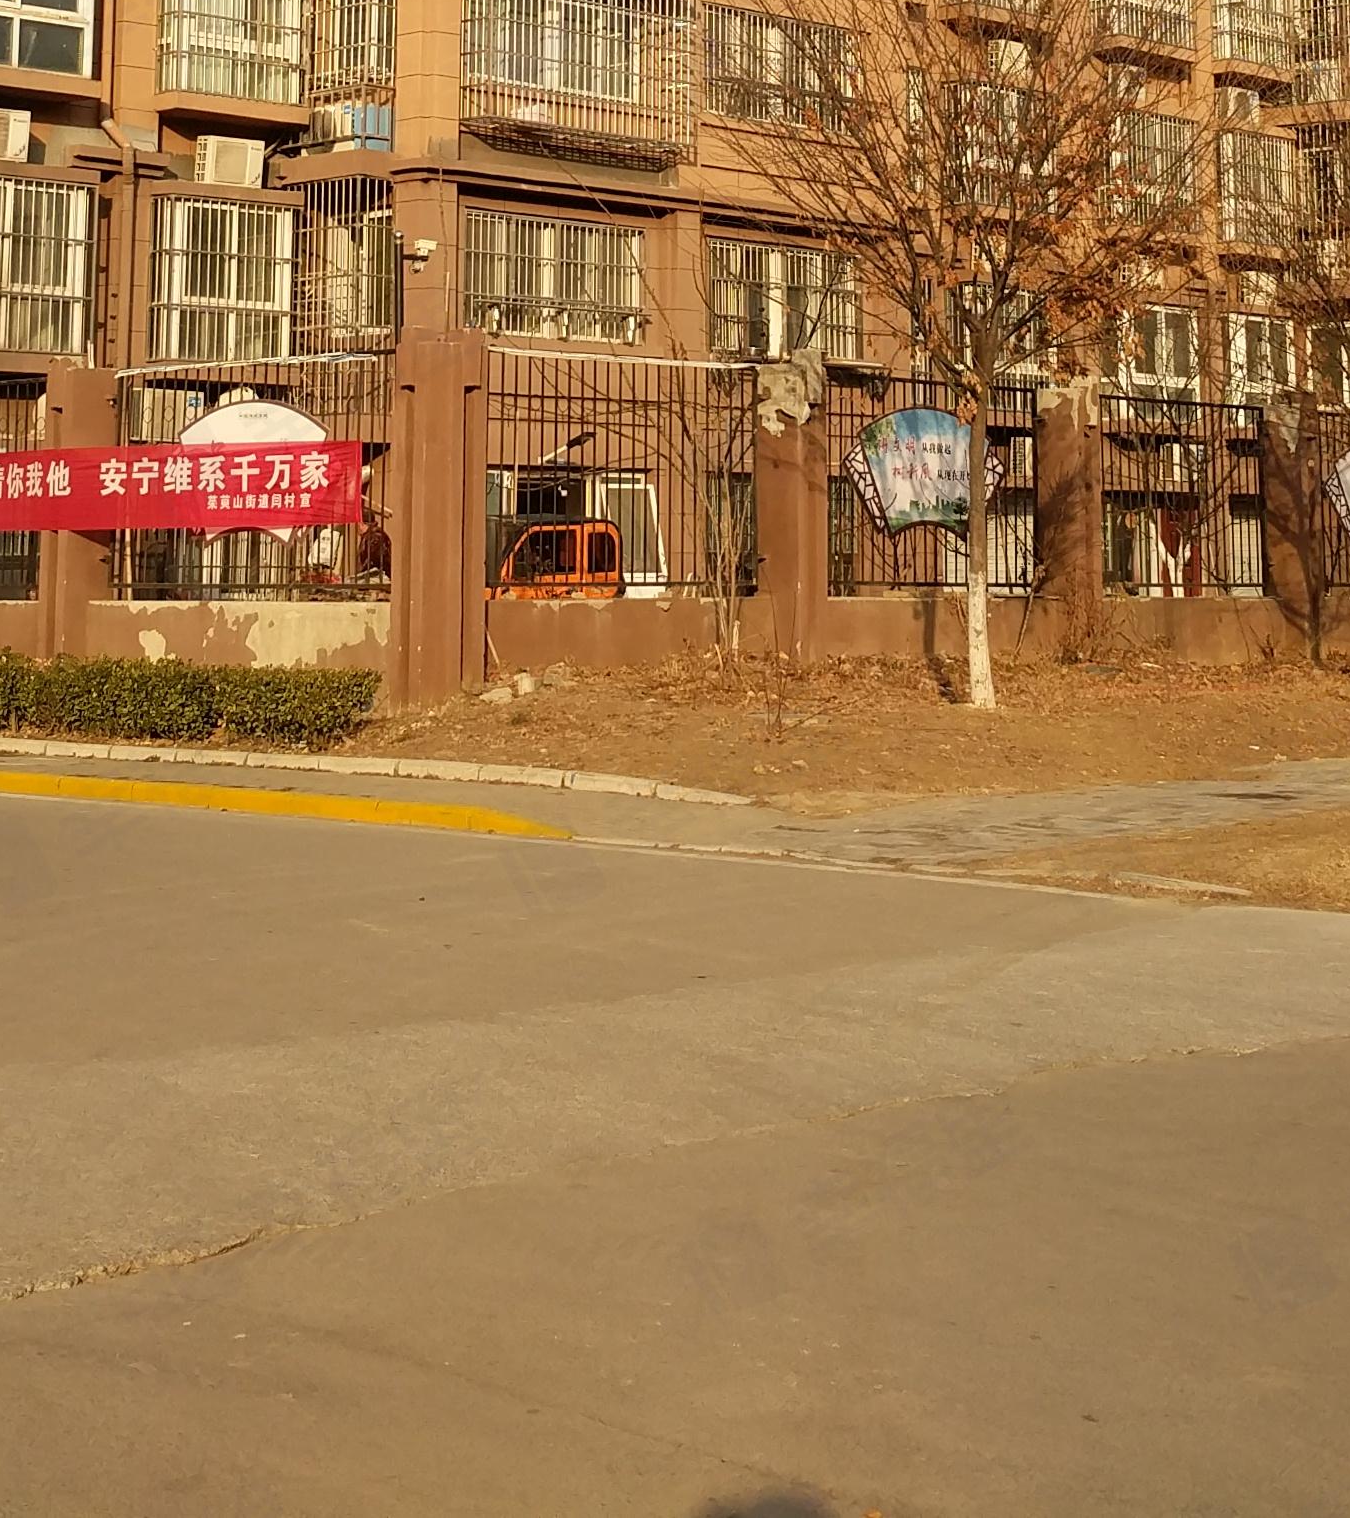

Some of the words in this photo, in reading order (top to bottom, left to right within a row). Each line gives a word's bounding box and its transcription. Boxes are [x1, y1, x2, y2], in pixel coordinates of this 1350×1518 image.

[99, 450, 330, 496] 安宁维系千万家
[300, 492, 312, 508] 宣
